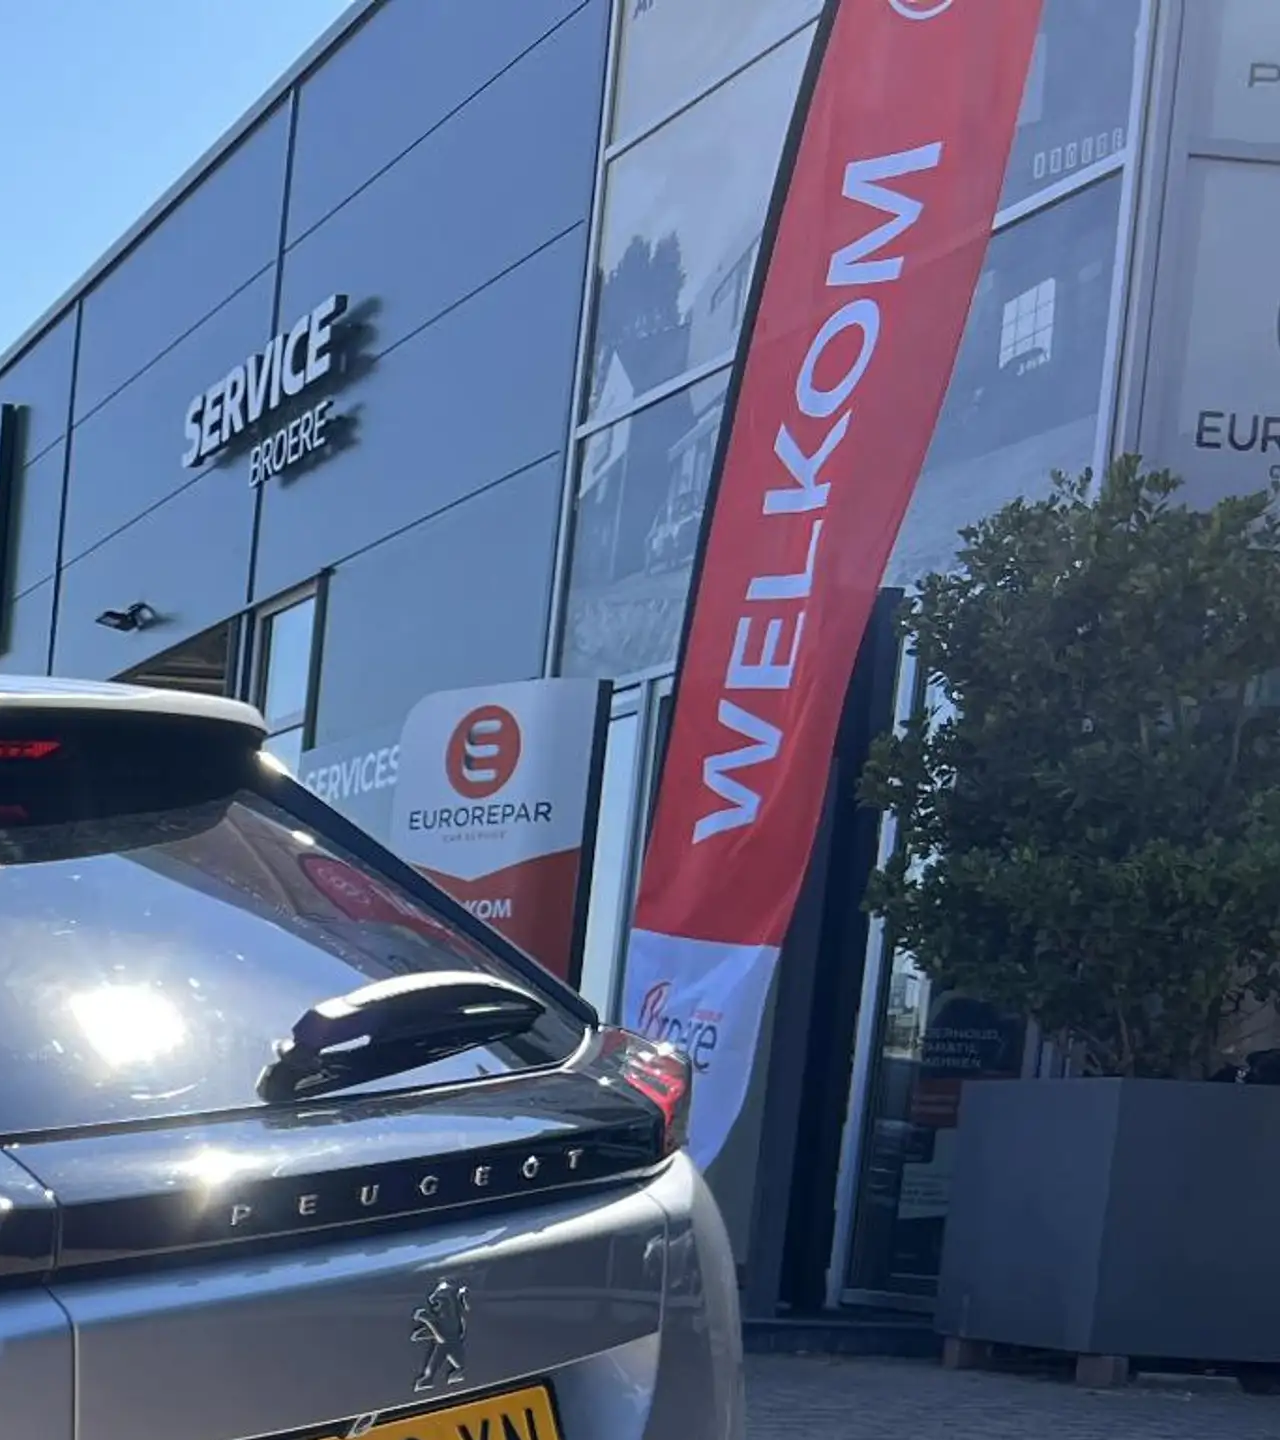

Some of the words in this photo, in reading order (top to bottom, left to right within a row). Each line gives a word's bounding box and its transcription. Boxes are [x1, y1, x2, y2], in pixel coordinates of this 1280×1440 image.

[182, 294, 343, 469] SERVICE
[248, 400, 331, 489] BROERE
[691, 141, 943, 844] WELKOM
[408, 801, 553, 831] EUROREPAR
[228, 1148, 584, 1227] PEUGEOT
